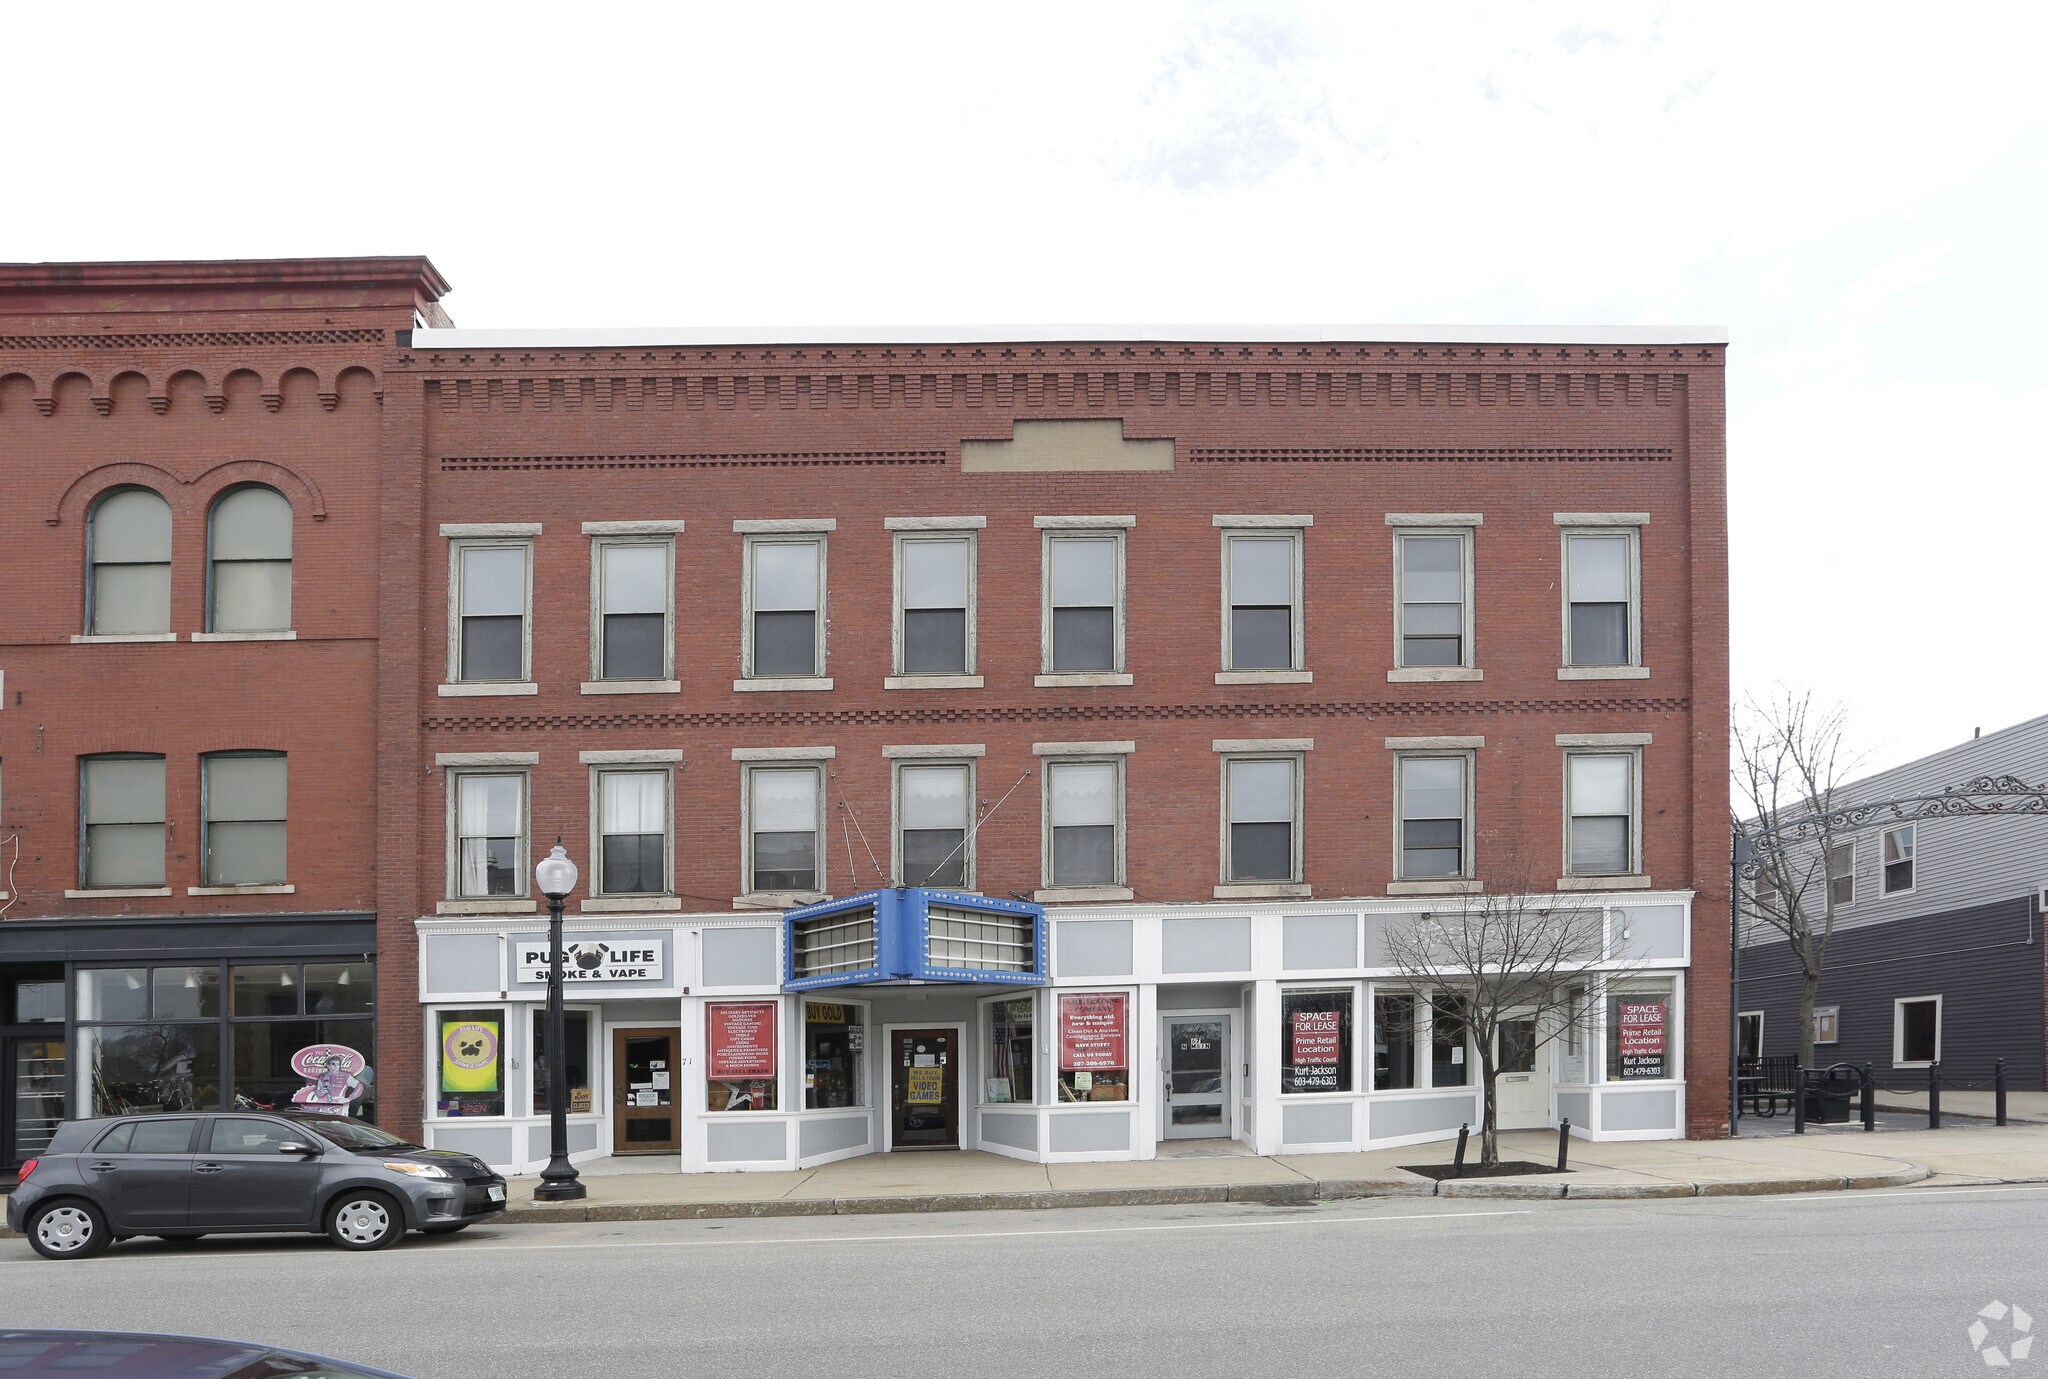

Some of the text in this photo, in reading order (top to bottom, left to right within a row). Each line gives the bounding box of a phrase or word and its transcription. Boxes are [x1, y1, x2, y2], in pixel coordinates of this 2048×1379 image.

[526, 950, 654, 964] PUG LIFE
[592, 970, 601, 978] &
[609, 969, 646, 978] VAPE
[806, 1005, 842, 1020] BUY GOLD
[1627, 1006, 1658, 1014] SPACE
[1300, 1012, 1332, 1021] SPACE
[1624, 1014, 1661, 1023] FOR LEASE
[1296, 1022, 1337, 1031] FOR LEASE
[1624, 1056, 1660, 1065] Kurt Jackson
[1294, 1065, 1336, 1075] Kurt Jackson
[1624, 1067, 1660, 1076] 603-479-6303
[1294, 1076, 1336, 1086] 603-479-6303
[914, 1082, 938, 1090] VIDEO
[910, 1092, 940, 1100] GAMES
